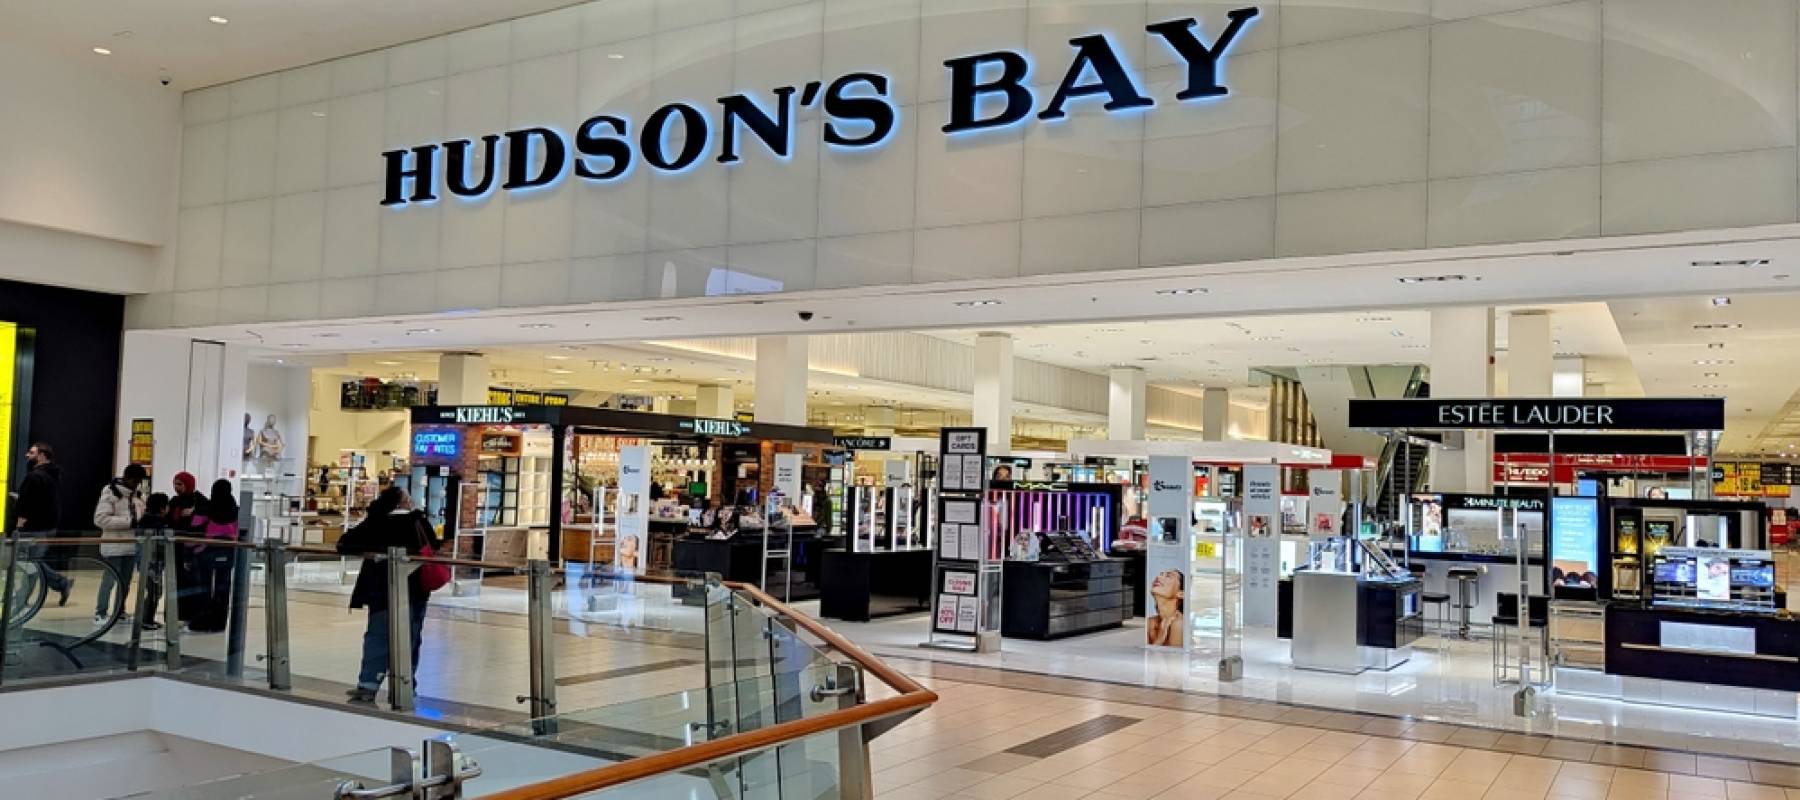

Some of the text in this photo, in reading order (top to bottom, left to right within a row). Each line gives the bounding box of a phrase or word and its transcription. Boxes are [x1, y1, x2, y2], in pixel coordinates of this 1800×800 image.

[380, 6, 1260, 206] HUDSON'S BAY
[456, 406, 513, 423] KIEHL'S
[1513, 404, 1614, 424] LAUDER
[694, 418, 742, 437] KIEHL'S
[415, 433, 456, 444] CUSTOMER
[1499, 468, 1549, 477] HISEIDO
